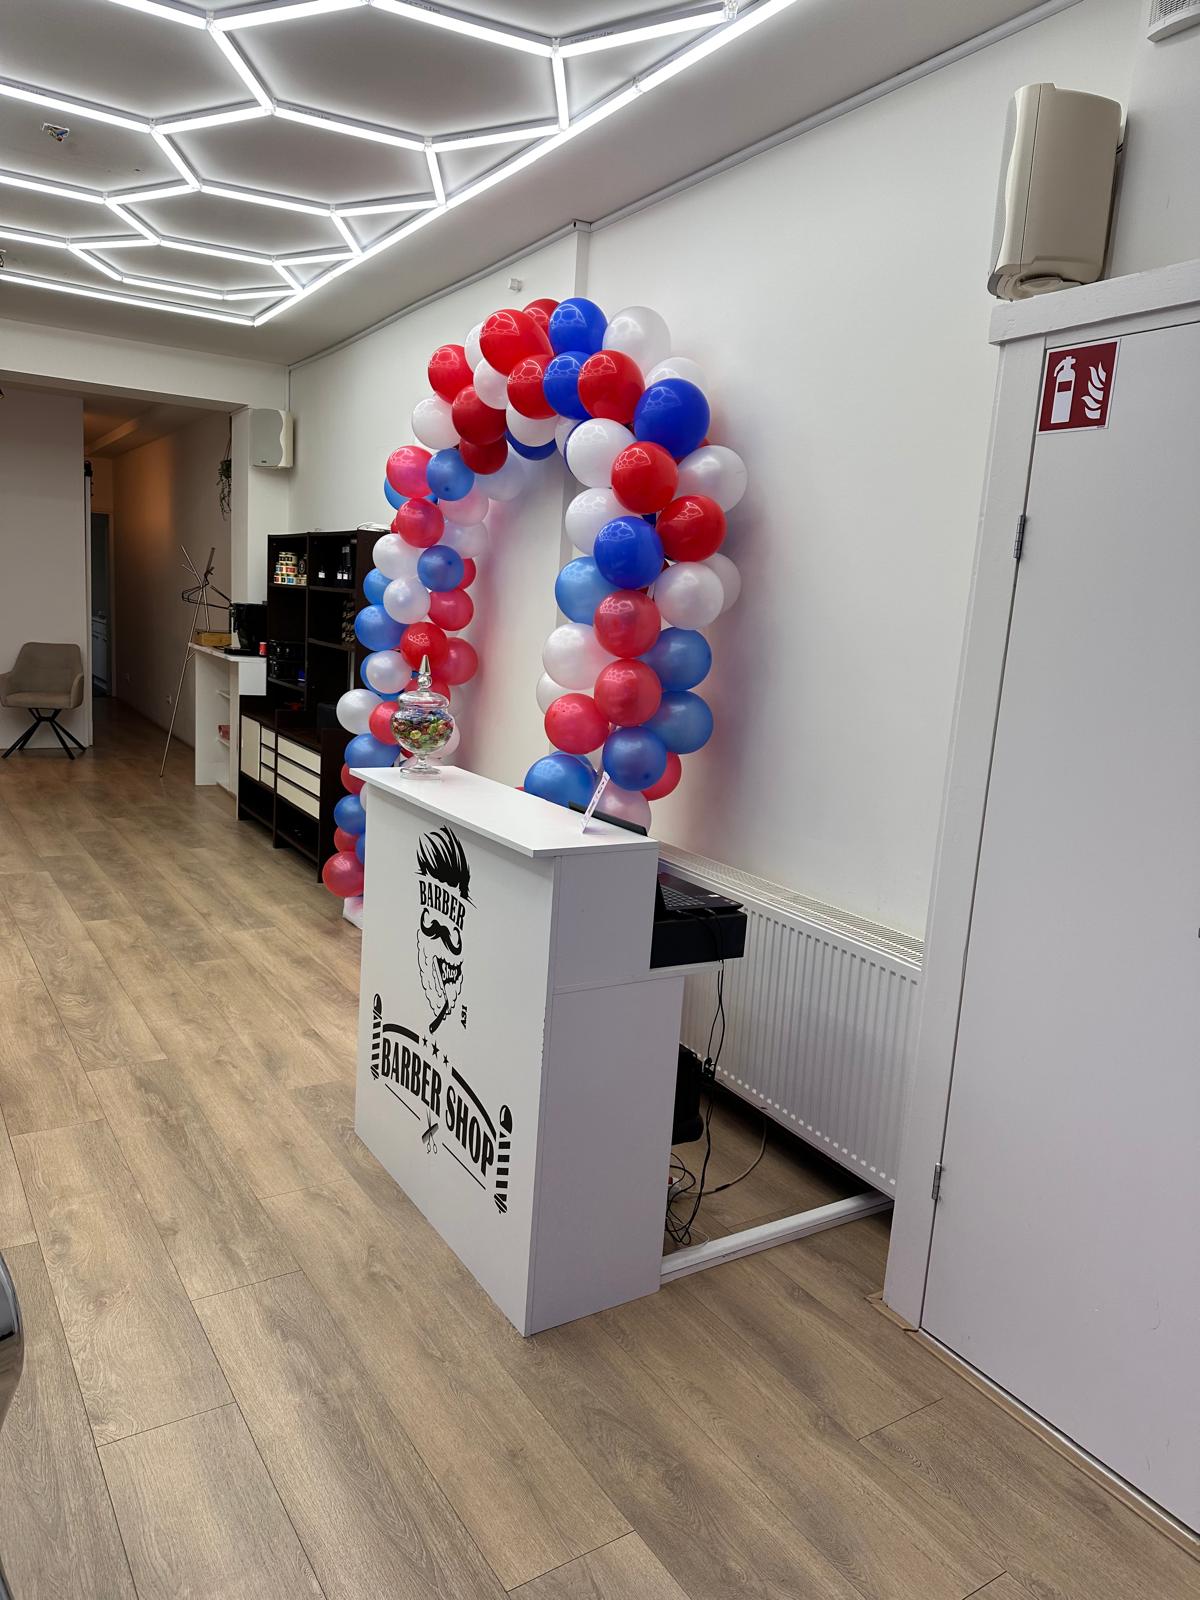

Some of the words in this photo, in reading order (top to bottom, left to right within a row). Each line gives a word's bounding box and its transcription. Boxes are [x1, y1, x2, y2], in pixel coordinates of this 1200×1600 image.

[419, 880, 466, 931] BARBER
[441, 962, 458, 981] Shop
[381, 1037, 442, 1118] BARBER
[445, 1085, 494, 1177] SHOP
